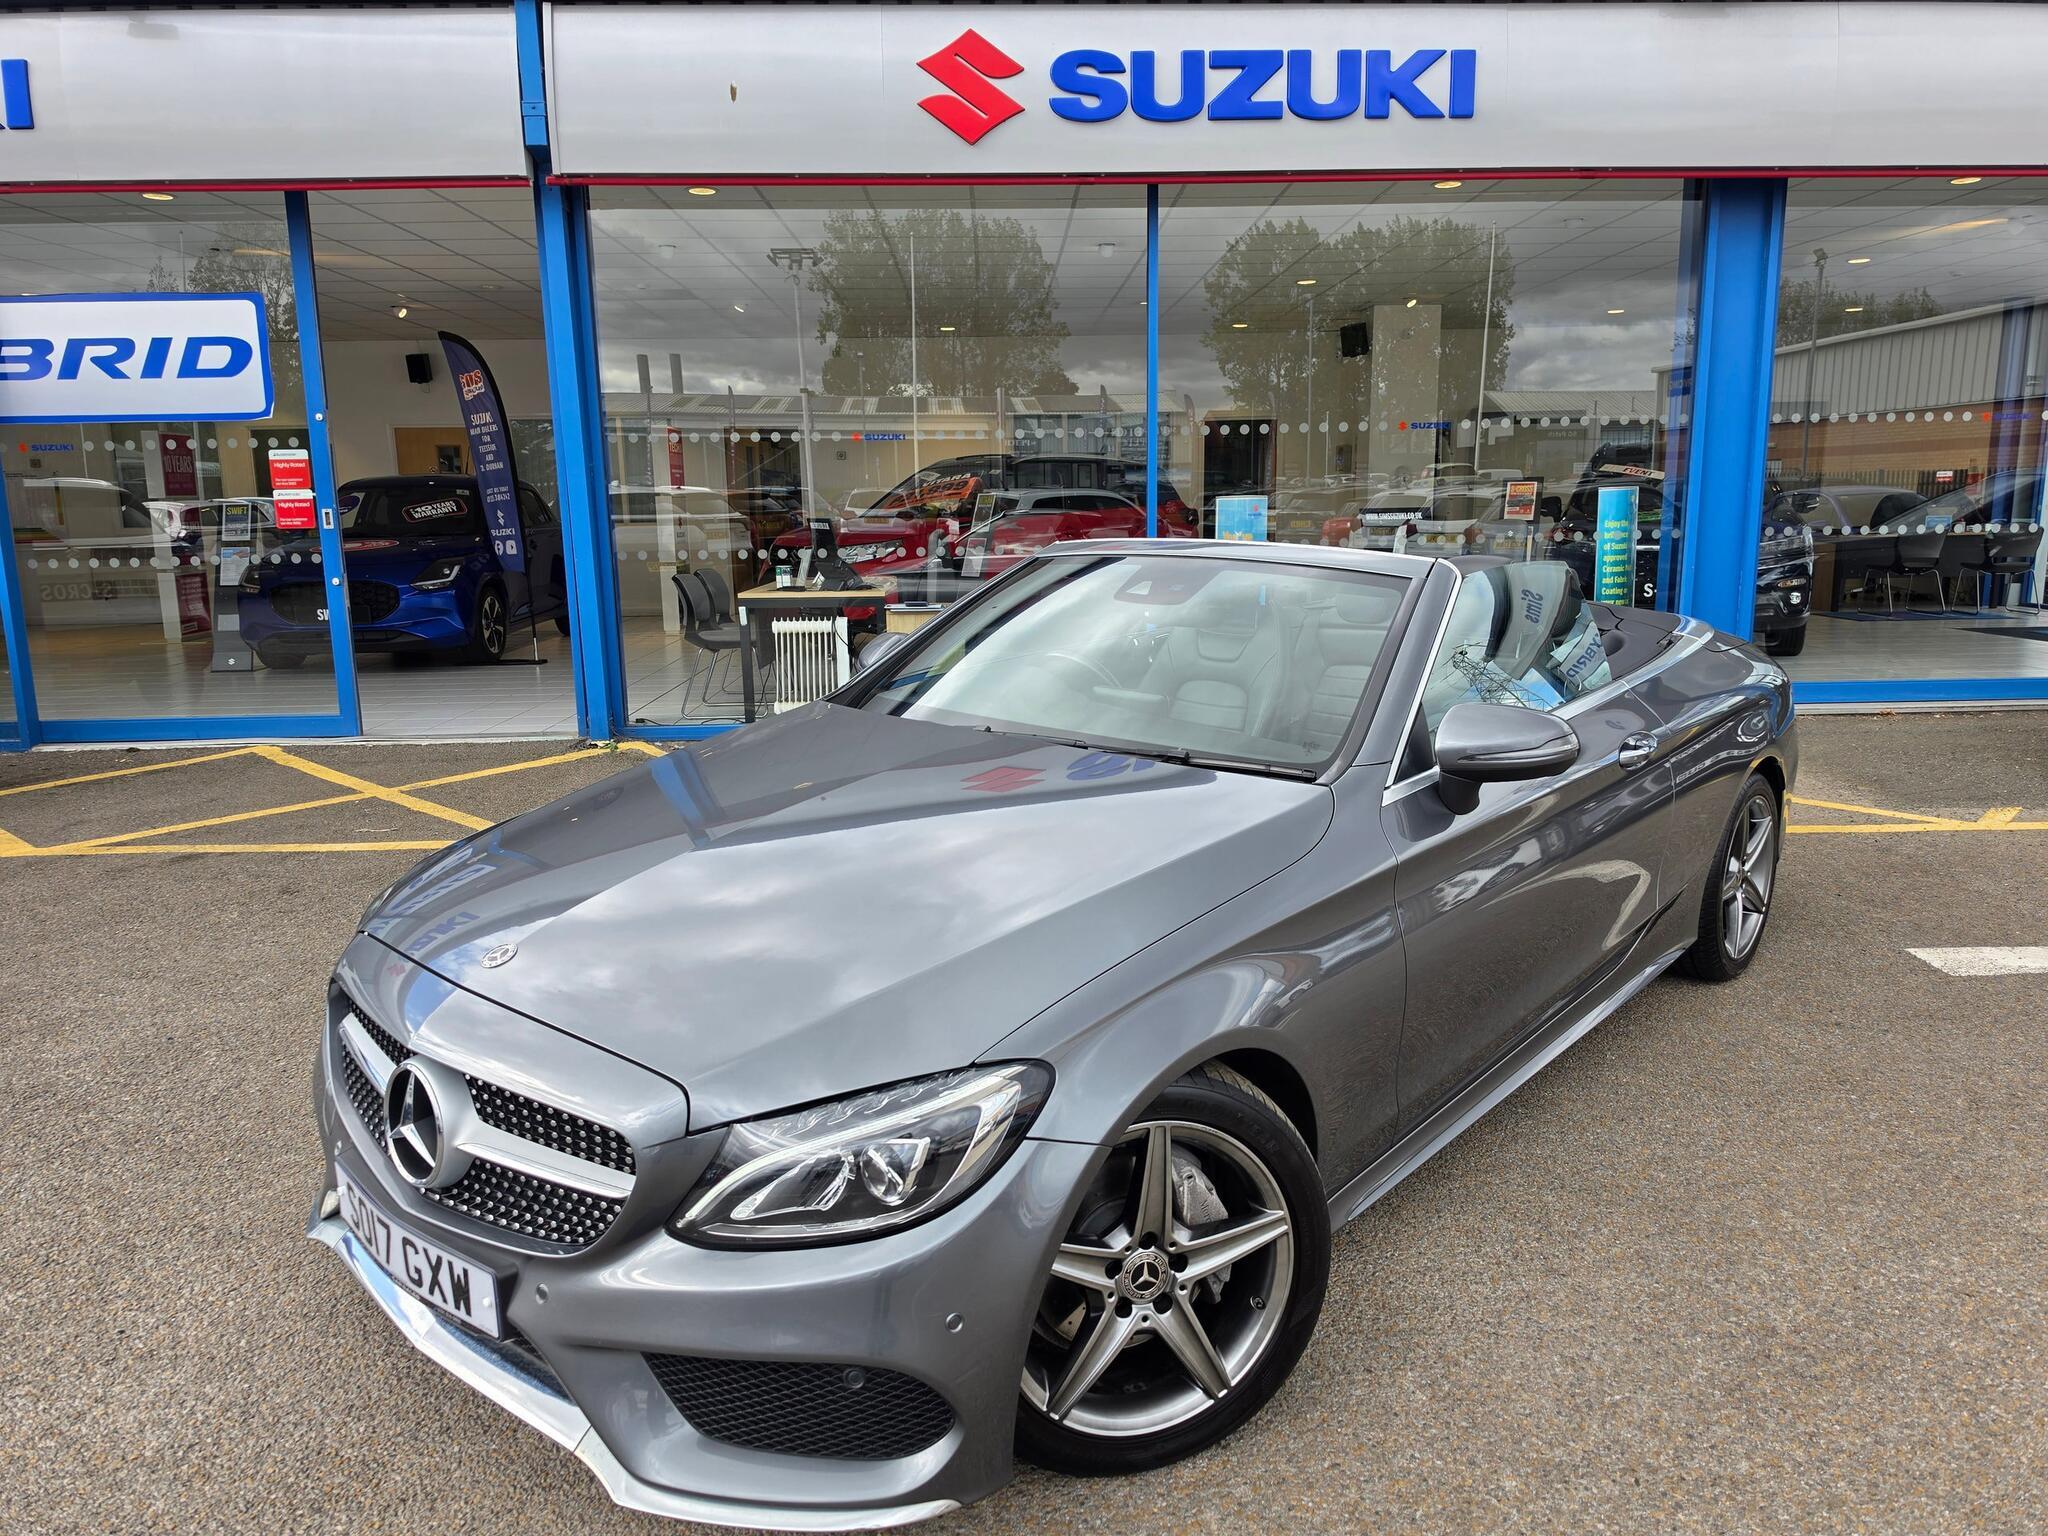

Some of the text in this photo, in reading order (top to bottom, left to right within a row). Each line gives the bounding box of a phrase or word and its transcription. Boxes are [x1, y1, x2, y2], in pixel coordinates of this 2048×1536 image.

[1049, 49, 1477, 122] SUZUKI
[864, 433, 906, 441] SUZUKI
[31, 444, 74, 452] SUZUKI
[171, 455, 193, 473] YEARS
[1624, 468, 1656, 476] EVENT
[226, 506, 247, 515] SWIFT
[412, 505, 459, 519] WARRANTY
[415, 501, 457, 513] 10 YEARS
[346, 1181, 472, 1318] SD17 GXW
